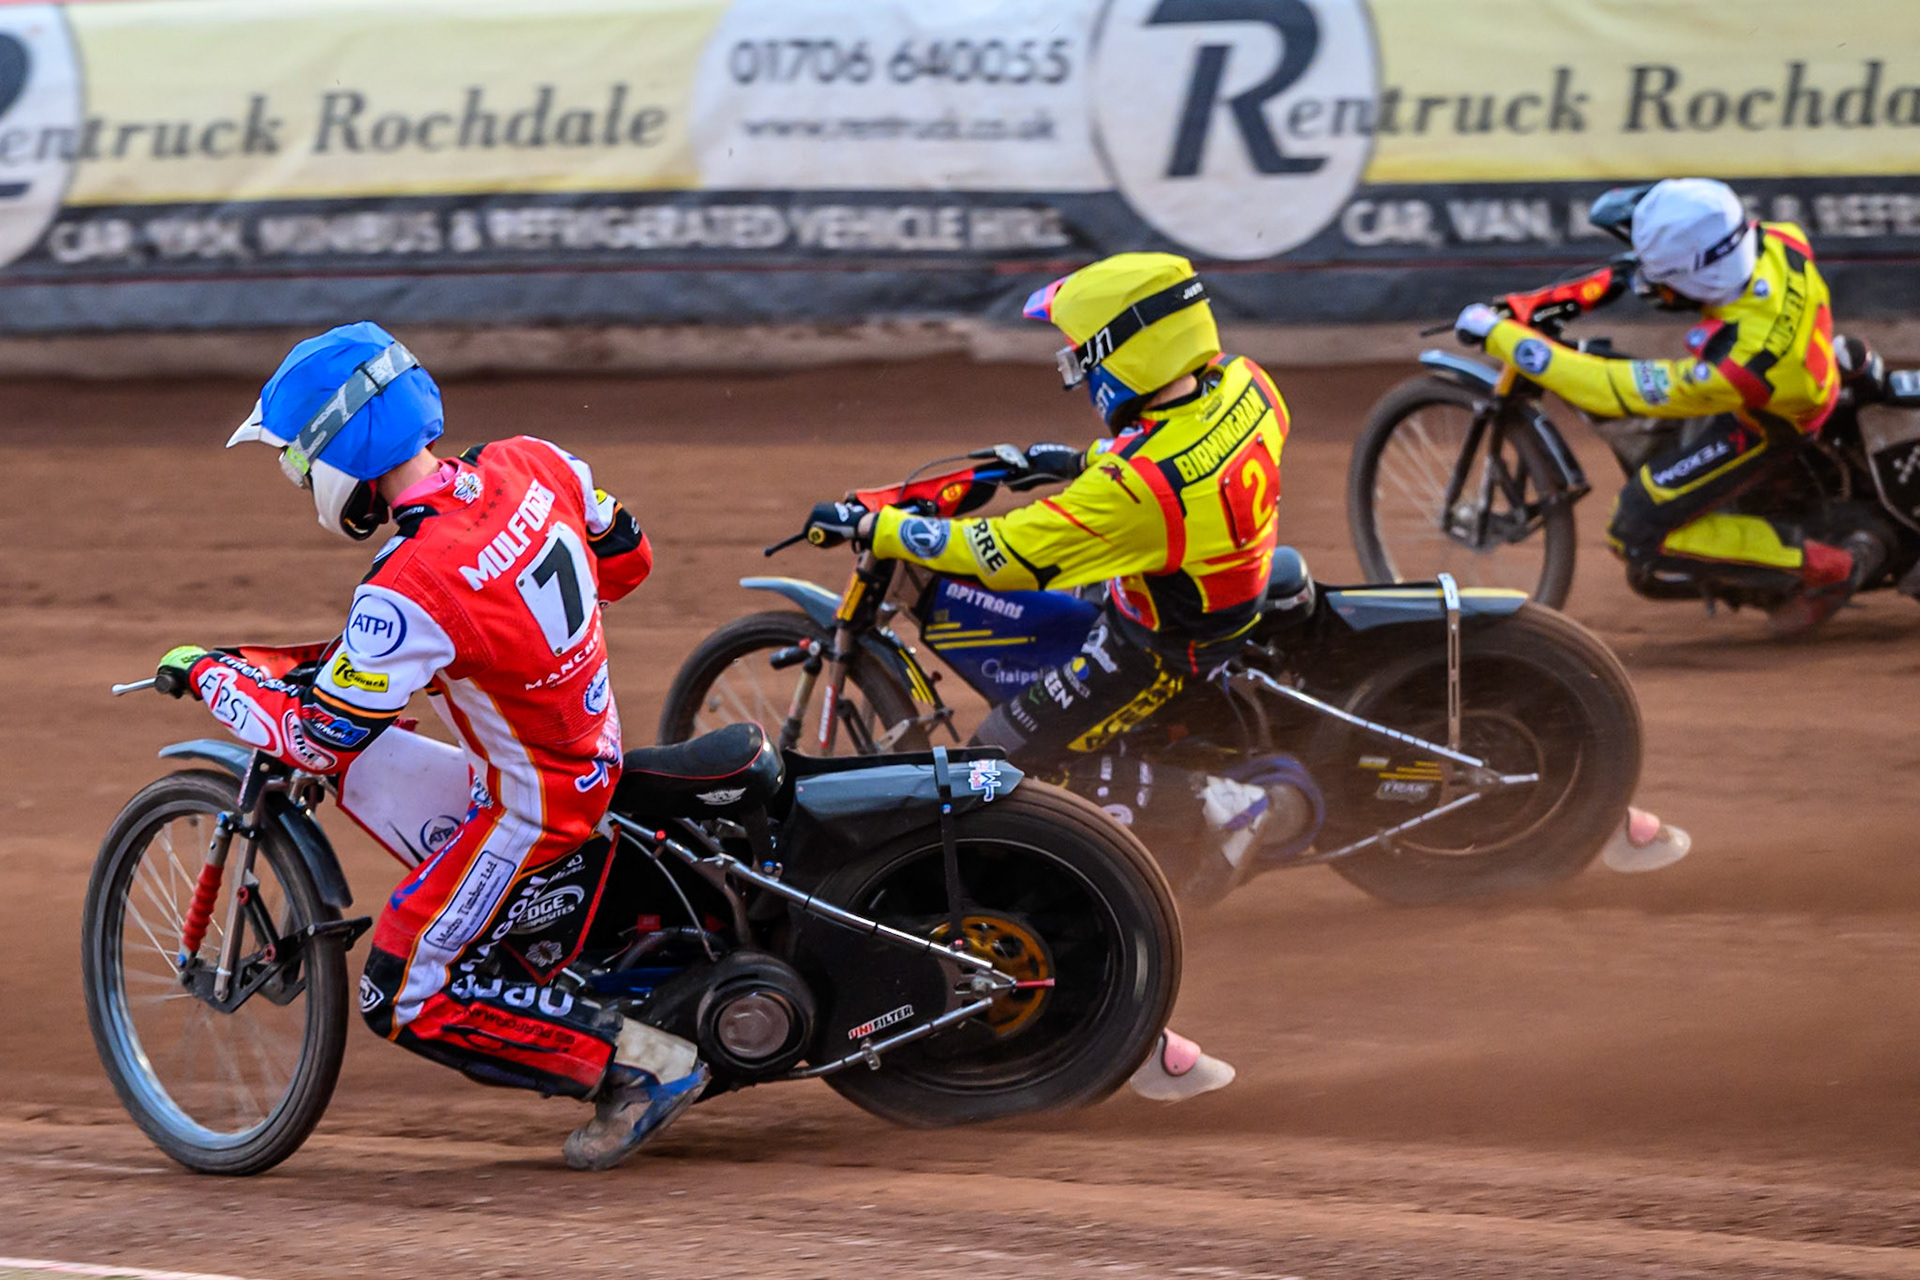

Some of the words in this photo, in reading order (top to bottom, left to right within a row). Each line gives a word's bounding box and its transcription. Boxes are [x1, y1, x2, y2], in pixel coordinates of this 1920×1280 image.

[730, 39, 873, 85] 01706
[887, 39, 1071, 85] 640055
[311, 84, 669, 155] Rochdale
[1173, 386, 1267, 484] BIRMINGHAM
[1242, 458, 1272, 530] 2
[531, 536, 585, 640] 7
[351, 613, 394, 639] ATPI
[457, 880, 487, 915] Timber
[480, 860, 498, 881] Ltd
[849, 1004, 914, 1040] UNIFILTER
